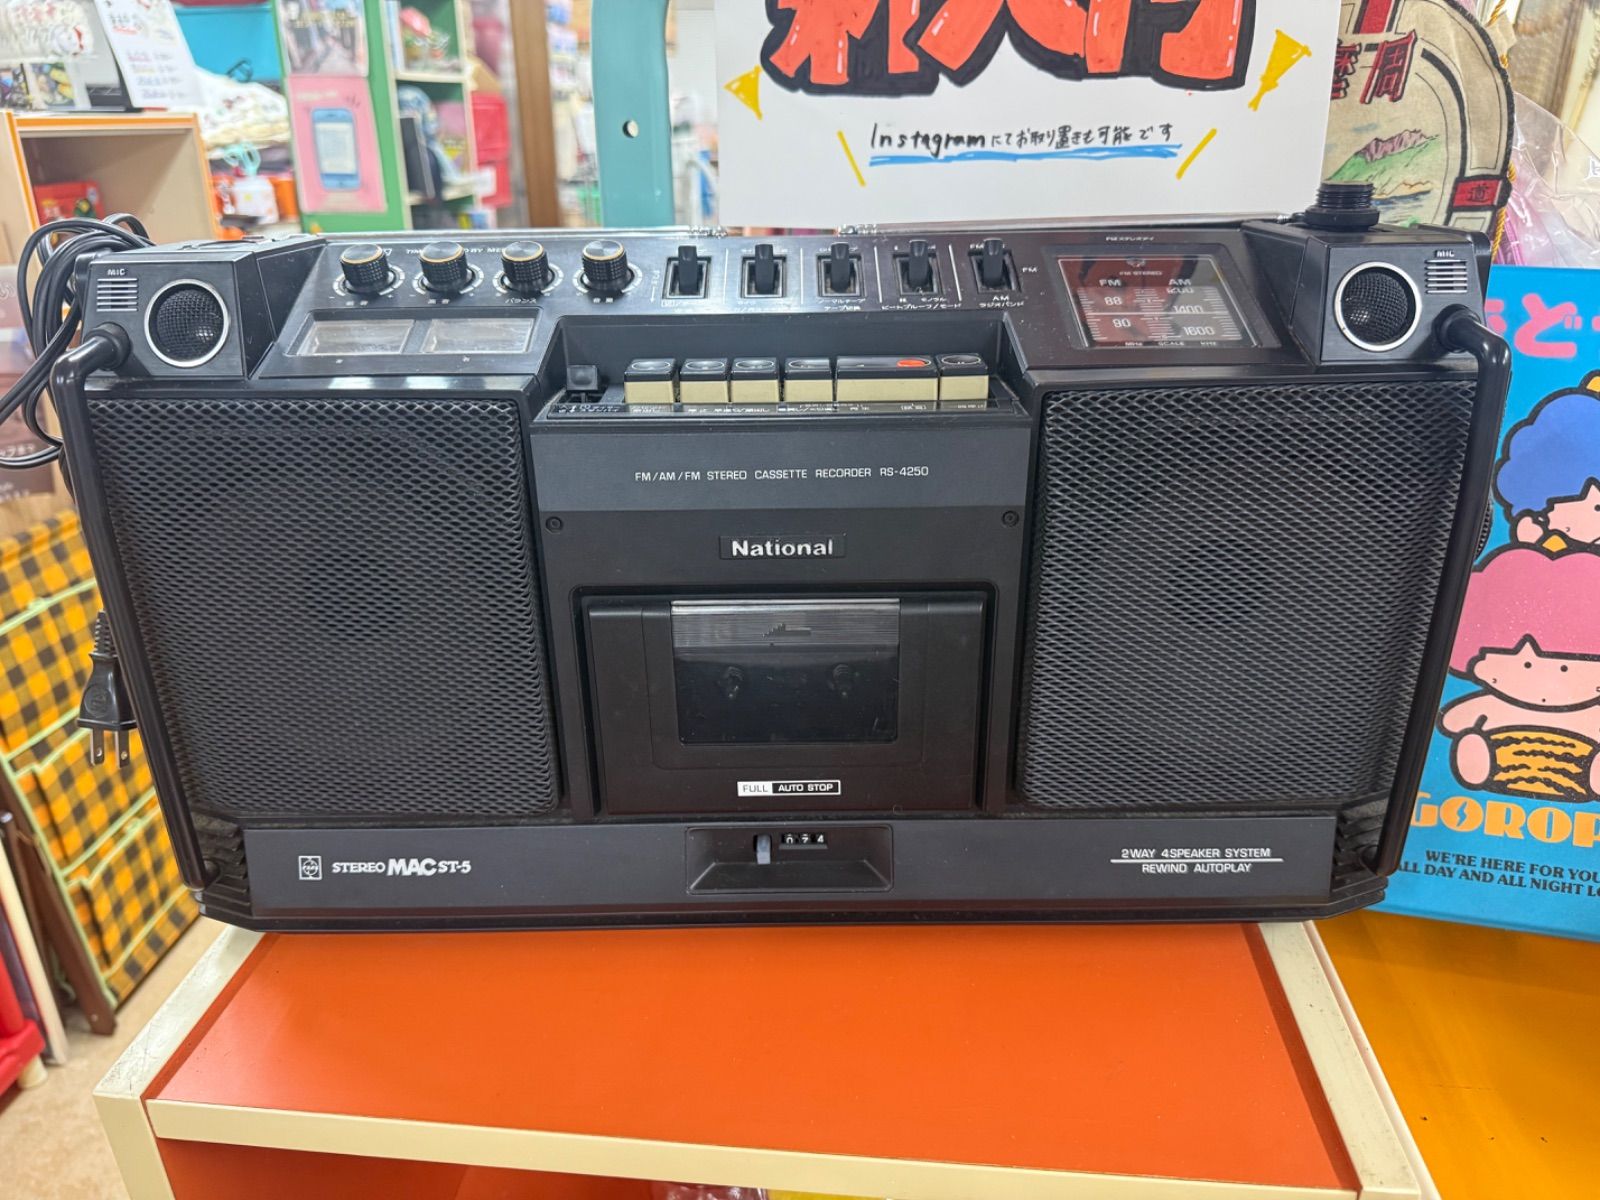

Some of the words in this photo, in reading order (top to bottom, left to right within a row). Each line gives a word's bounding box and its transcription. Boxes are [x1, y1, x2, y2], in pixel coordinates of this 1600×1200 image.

[107, 268, 127, 276] MIC
[1099, 278, 1122, 287] FM
[1168, 278, 1192, 286] AM
[1104, 296, 1123, 306] 88
[1173, 305, 1204, 314] 1400
[1183, 326, 1215, 336] 1600
[707, 470, 747, 480] STEREO
[754, 469, 808, 479] CASSETTE
[815, 467, 872, 478] RECORDER
[879, 466, 929, 477] RS-4250
[731, 539, 834, 557] National
[742, 784, 769, 793] FULL
[778, 784, 804, 792] AUTO
[807, 783, 834, 792] STOP
[1121, 848, 1156, 859] 2WAY
[1161, 848, 1221, 858] 4SPEAKER
[1225, 847, 1271, 858] SYSTEM
[331, 862, 386, 873] STEREO
[386, 858, 437, 876] MAC
[437, 860, 472, 873] ST-5
[1142, 863, 1187, 873] REWIND
[1193, 862, 1252, 873] AUTOPLAY
[1425, 849, 1477, 867] WE'RE
[1481, 857, 1526, 874] HERE
[1529, 863, 1565, 879] FOR
[1399, 861, 1421, 874] LL
[1424, 864, 1457, 879] DAY
[1459, 868, 1495, 883] AND
[1498, 874, 1527, 888] ALL
[1530, 877, 1584, 895] NIGHT
